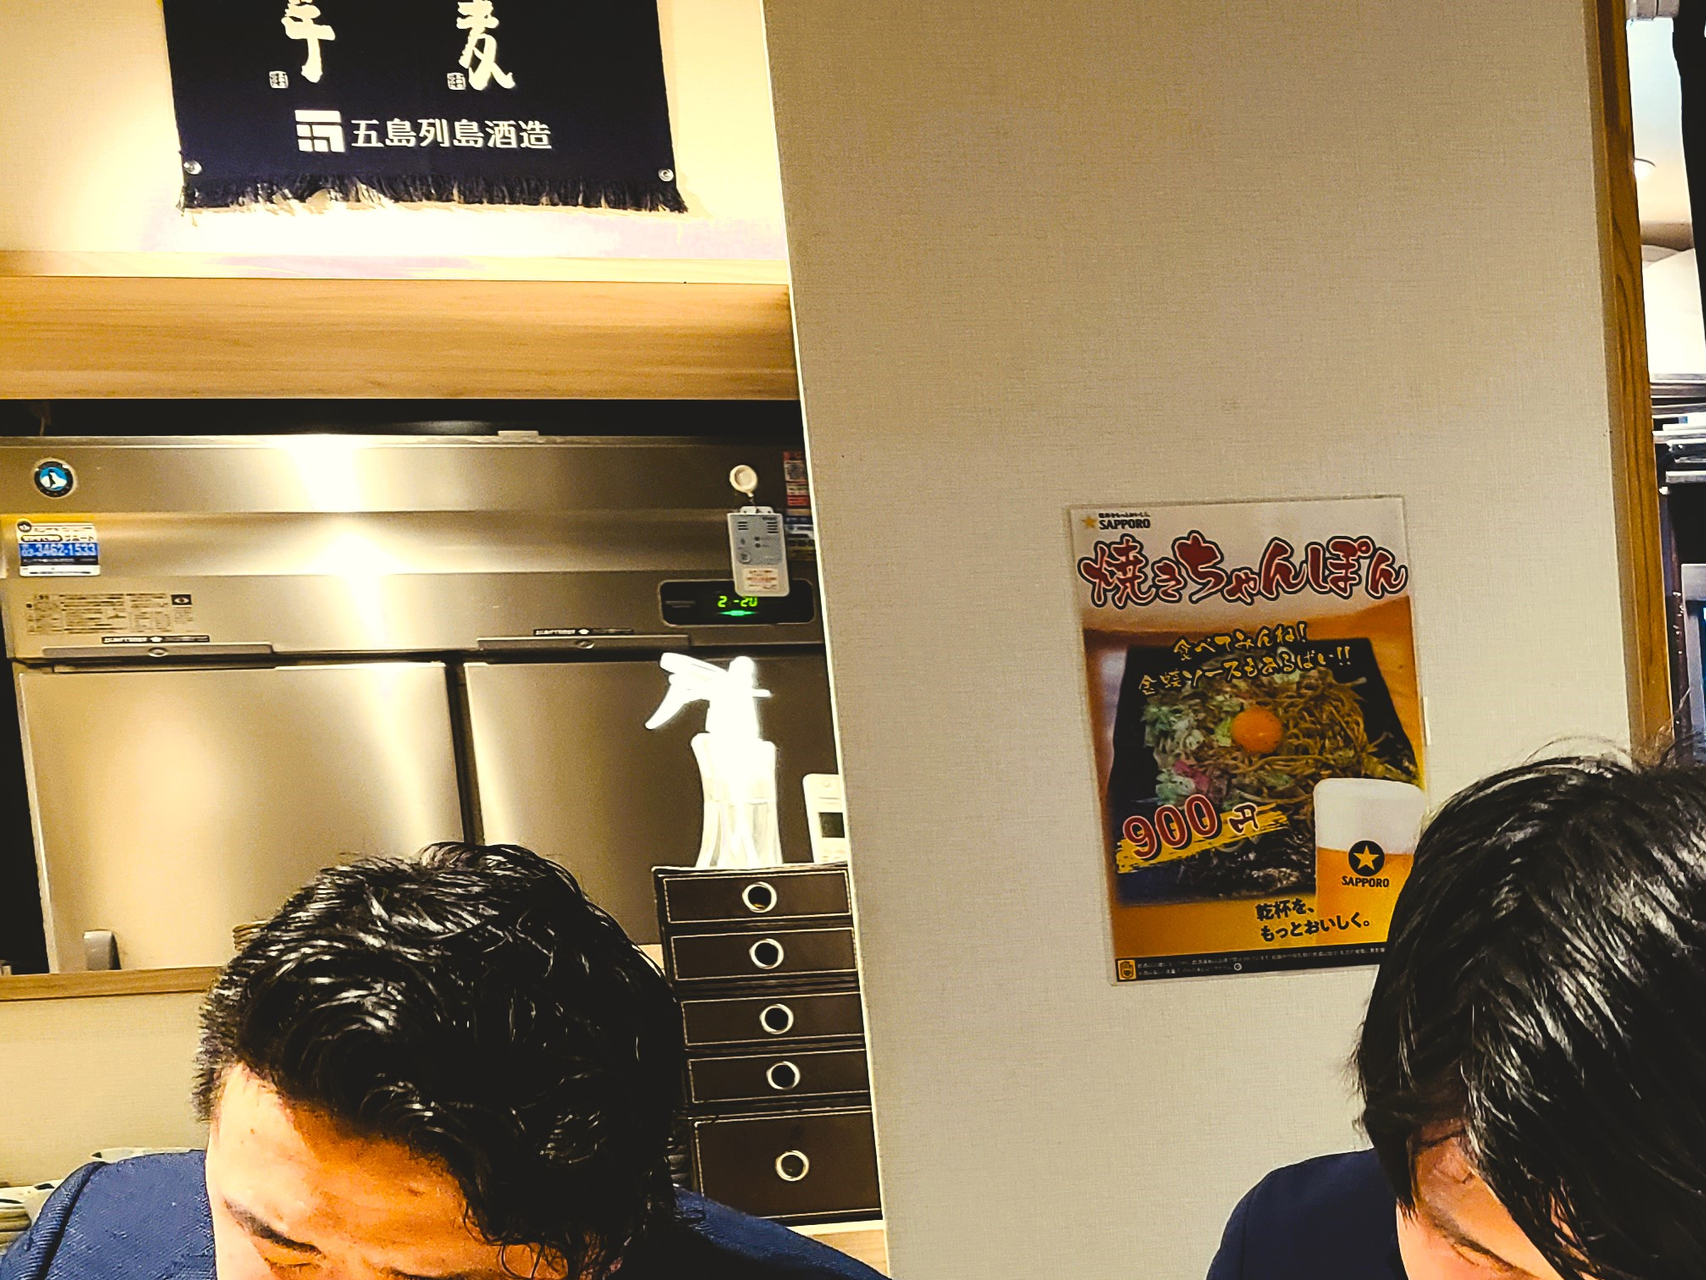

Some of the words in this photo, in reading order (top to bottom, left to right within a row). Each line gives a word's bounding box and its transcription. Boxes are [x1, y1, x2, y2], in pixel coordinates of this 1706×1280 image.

[350, 118, 553, 150] 五島列島酒造
[1099, 518, 1151, 530] SAPPORO
[1078, 531, 1408, 609] 焼きちゃんぽん
[1341, 876, 1390, 888] SAPPORO
[1255, 898, 1315, 922] 乾杯を、
[1260, 912, 1371, 942] もっとおいしく。
